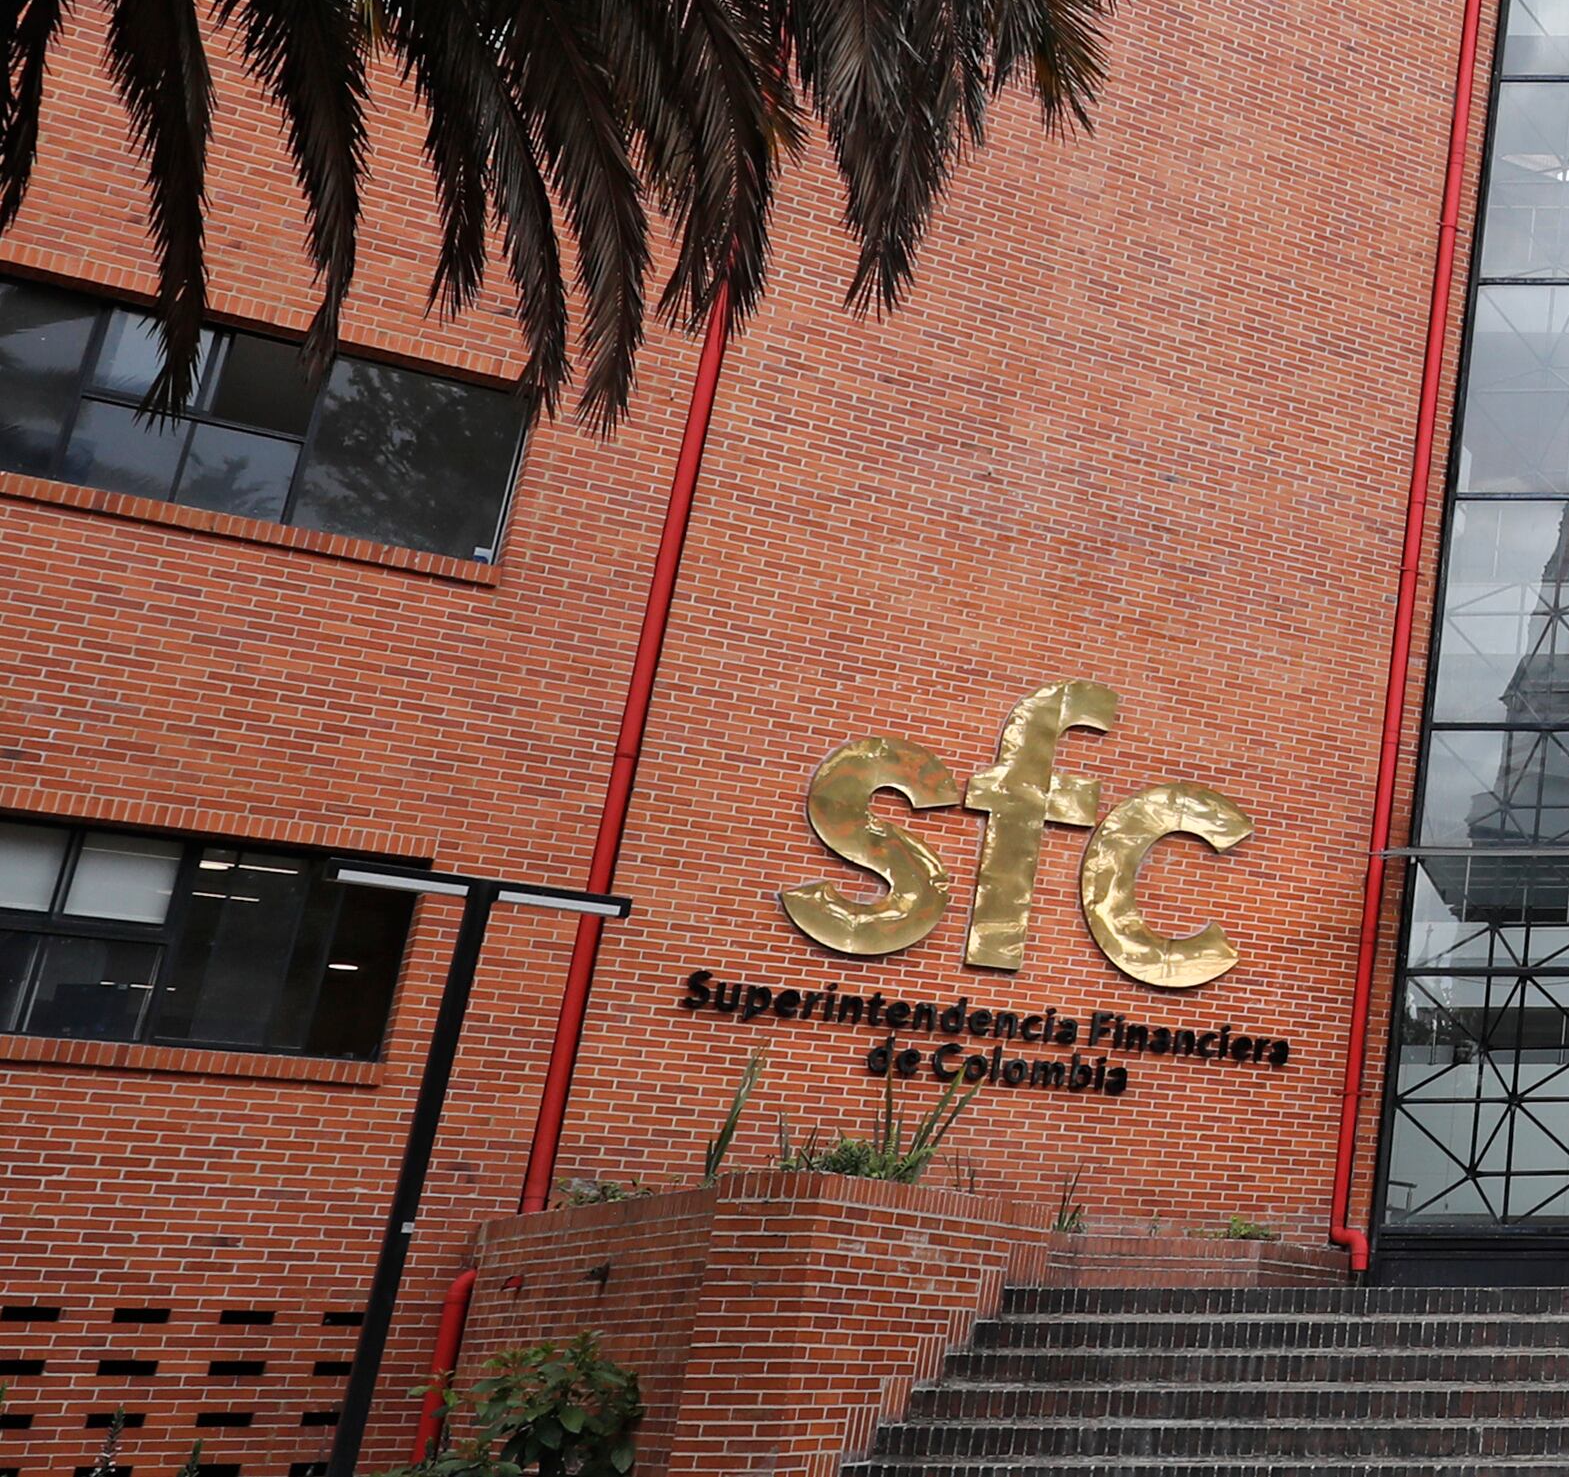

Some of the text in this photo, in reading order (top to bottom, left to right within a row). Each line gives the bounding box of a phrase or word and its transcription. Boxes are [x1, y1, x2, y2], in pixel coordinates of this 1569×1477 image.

[779, 679, 1254, 988] sfc
[683, 970, 1290, 1066] Superintendencia Financiera
[866, 1035, 1128, 1095] de Colombia
